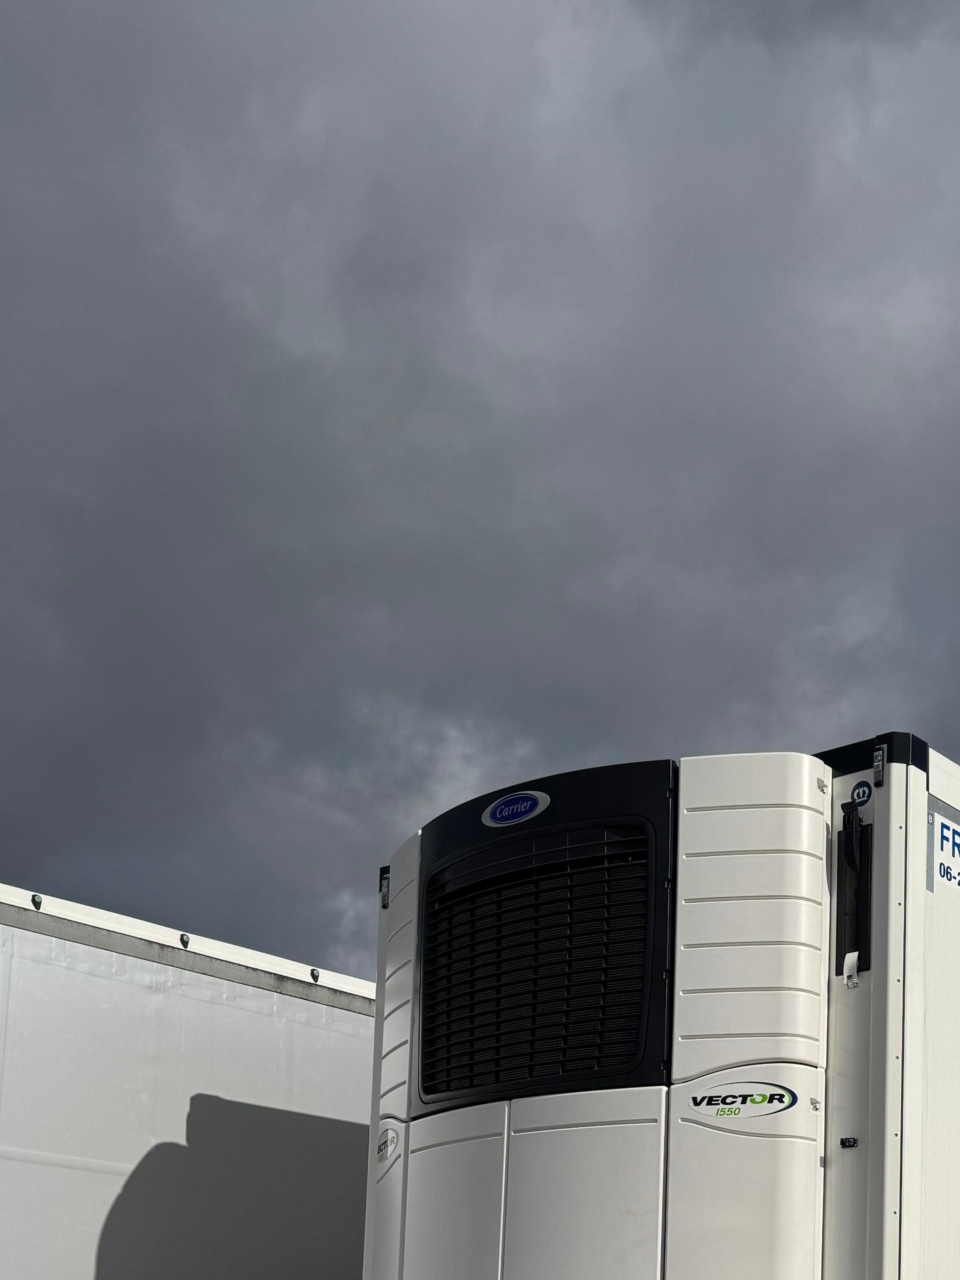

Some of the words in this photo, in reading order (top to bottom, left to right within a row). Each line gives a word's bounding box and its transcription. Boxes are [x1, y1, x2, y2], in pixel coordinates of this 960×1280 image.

[496, 801, 533, 818] Carrier
[691, 1093, 786, 1107] VECTOR
[715, 1107, 741, 1117] 1550
